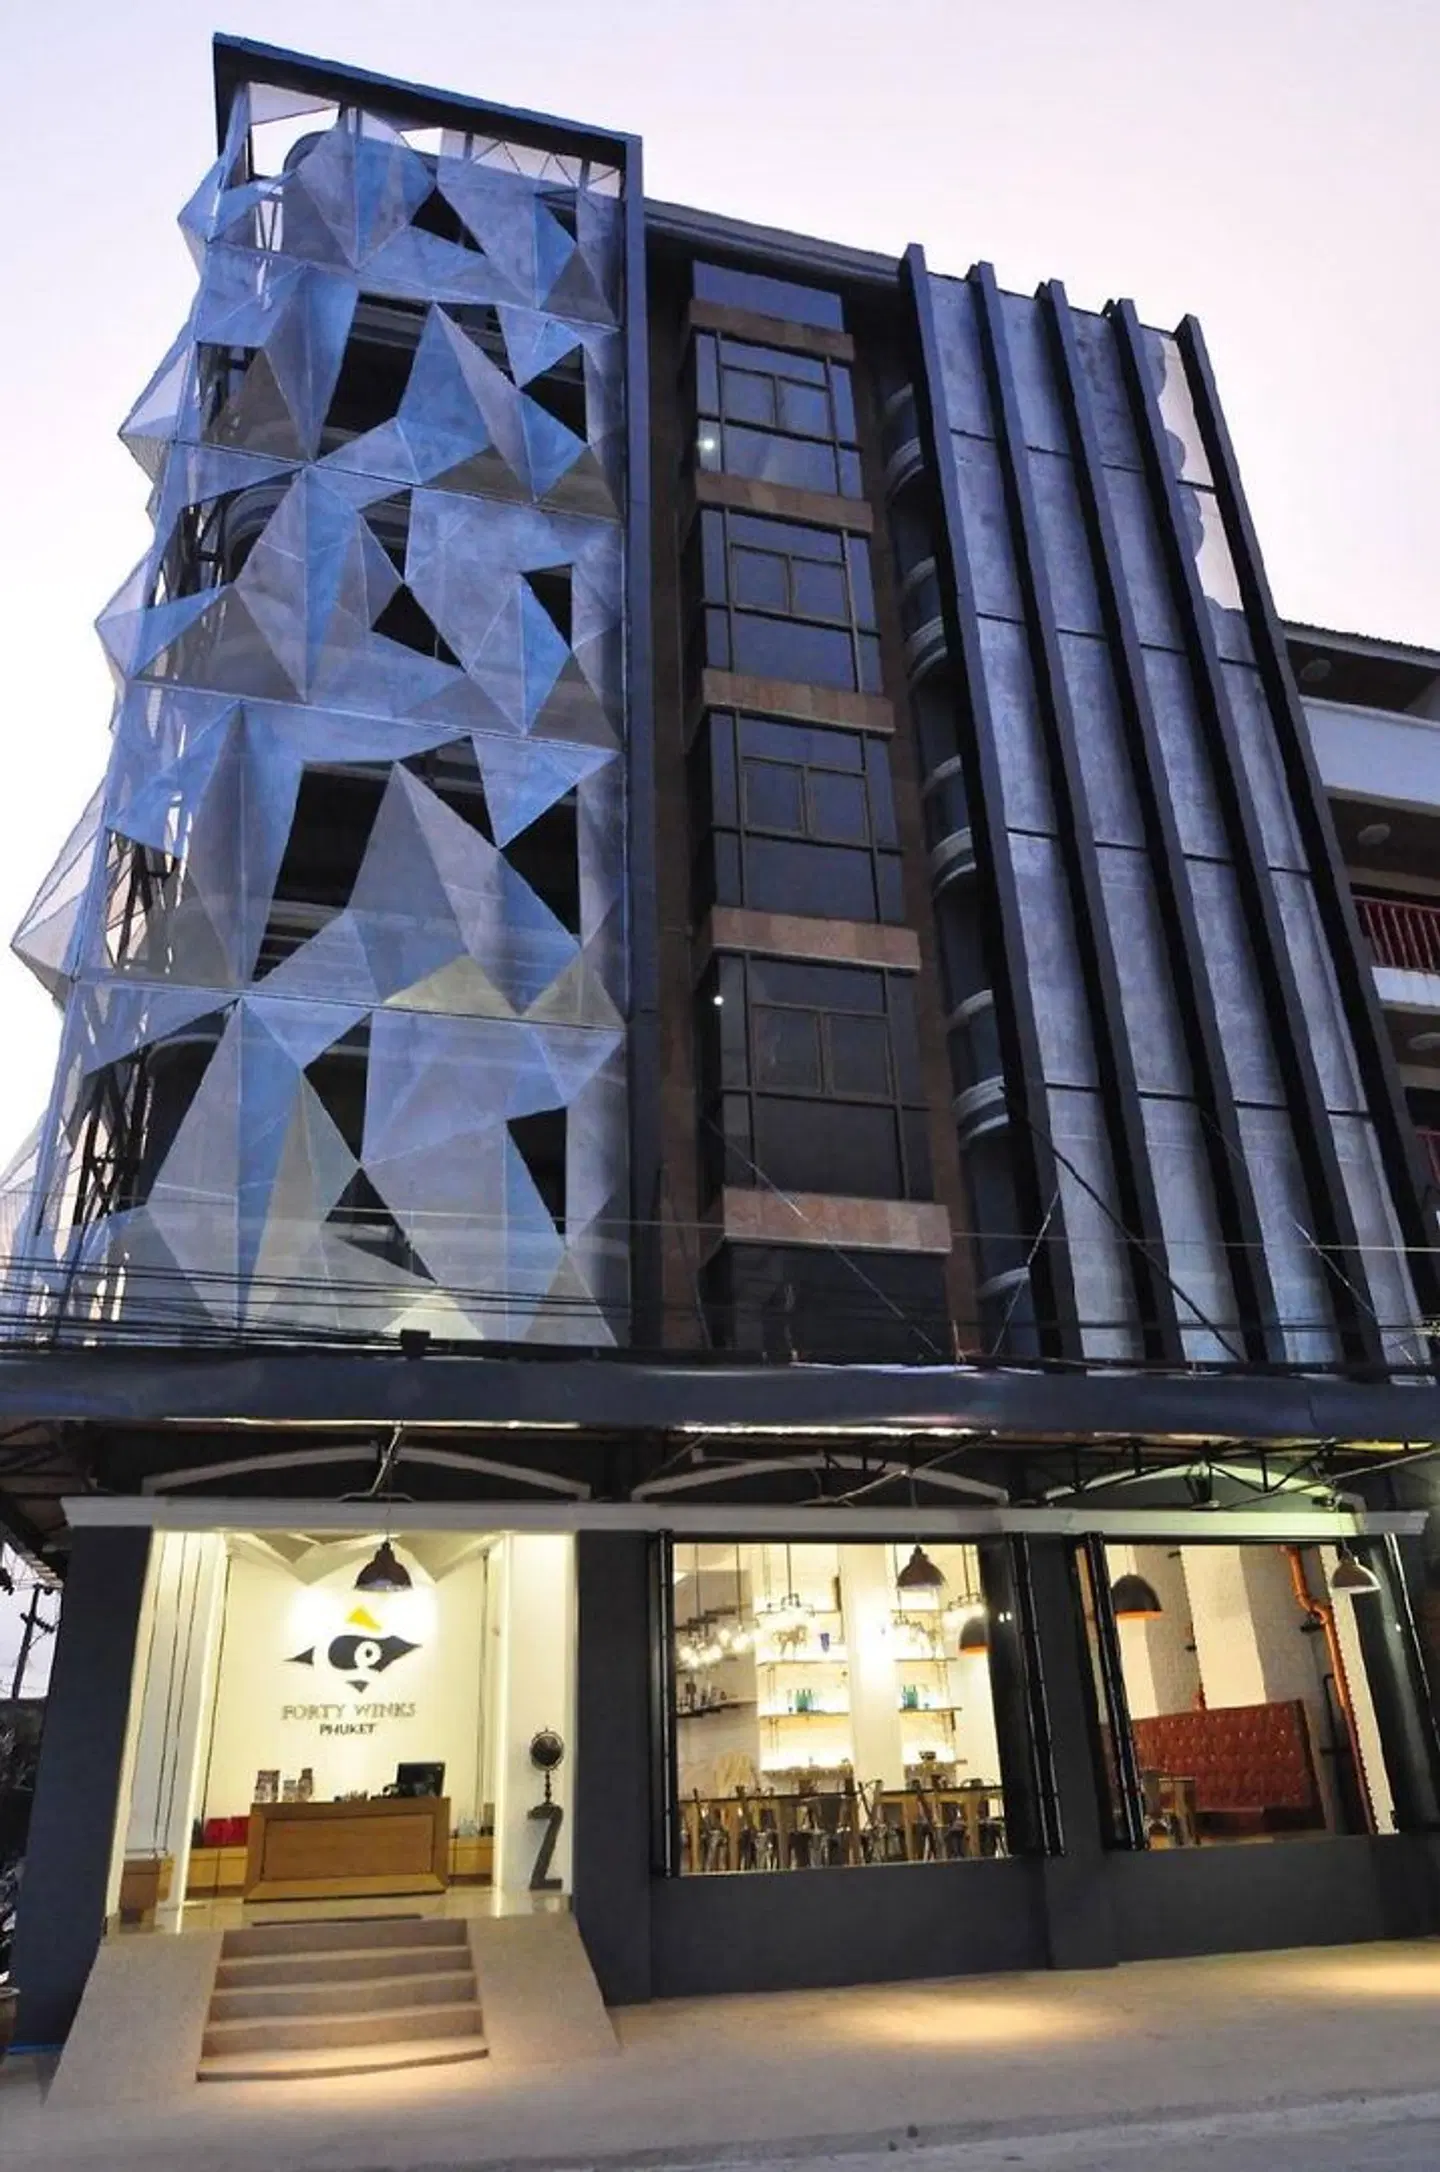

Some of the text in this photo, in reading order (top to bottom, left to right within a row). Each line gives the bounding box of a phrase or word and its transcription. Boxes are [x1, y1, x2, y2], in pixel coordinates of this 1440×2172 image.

[281, 1701, 417, 1721] FORTY WINKS
[319, 1723, 376, 1736] PHUKET
